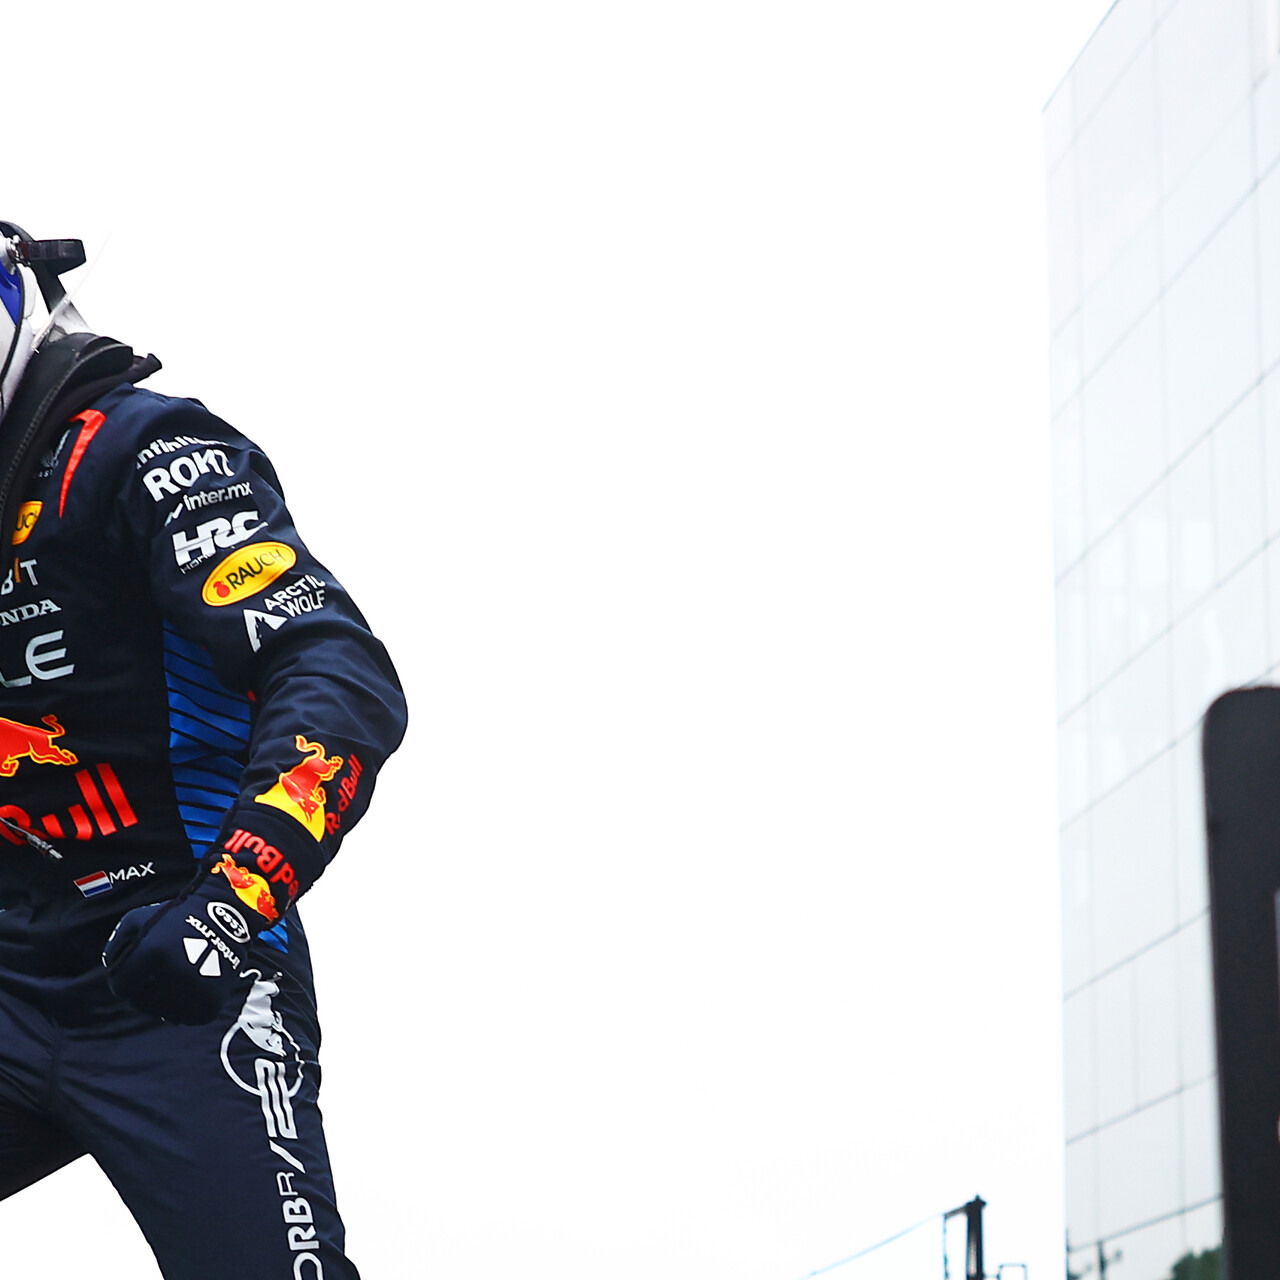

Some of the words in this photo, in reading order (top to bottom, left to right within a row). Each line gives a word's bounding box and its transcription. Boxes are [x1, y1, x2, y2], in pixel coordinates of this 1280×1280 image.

[183, 481, 254, 511] inter.mx
[172, 511, 269, 567] HRC
[225, 548, 286, 590] RAUCH
[109, 862, 156, 883] MAX
